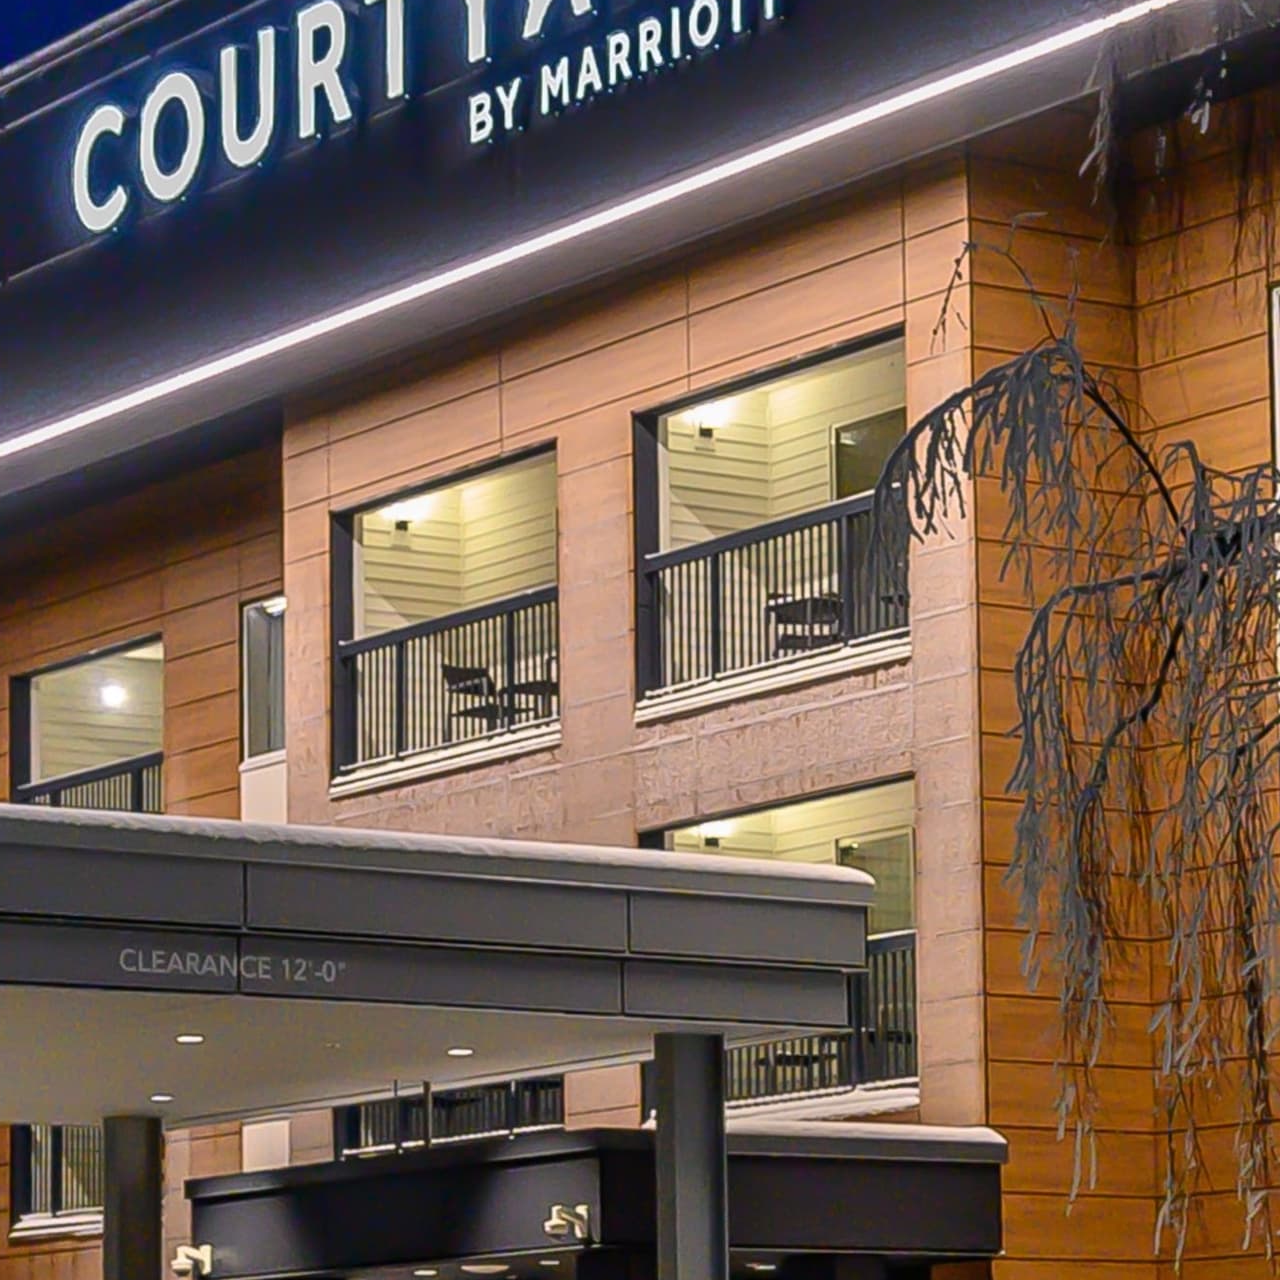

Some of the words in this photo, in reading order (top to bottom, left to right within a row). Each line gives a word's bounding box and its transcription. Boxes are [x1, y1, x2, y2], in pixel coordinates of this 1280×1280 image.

[469, 77, 521, 144] BY
[120, 948, 271, 980] CLEARANCE
[281, 958, 347, 983] 12'-0"
